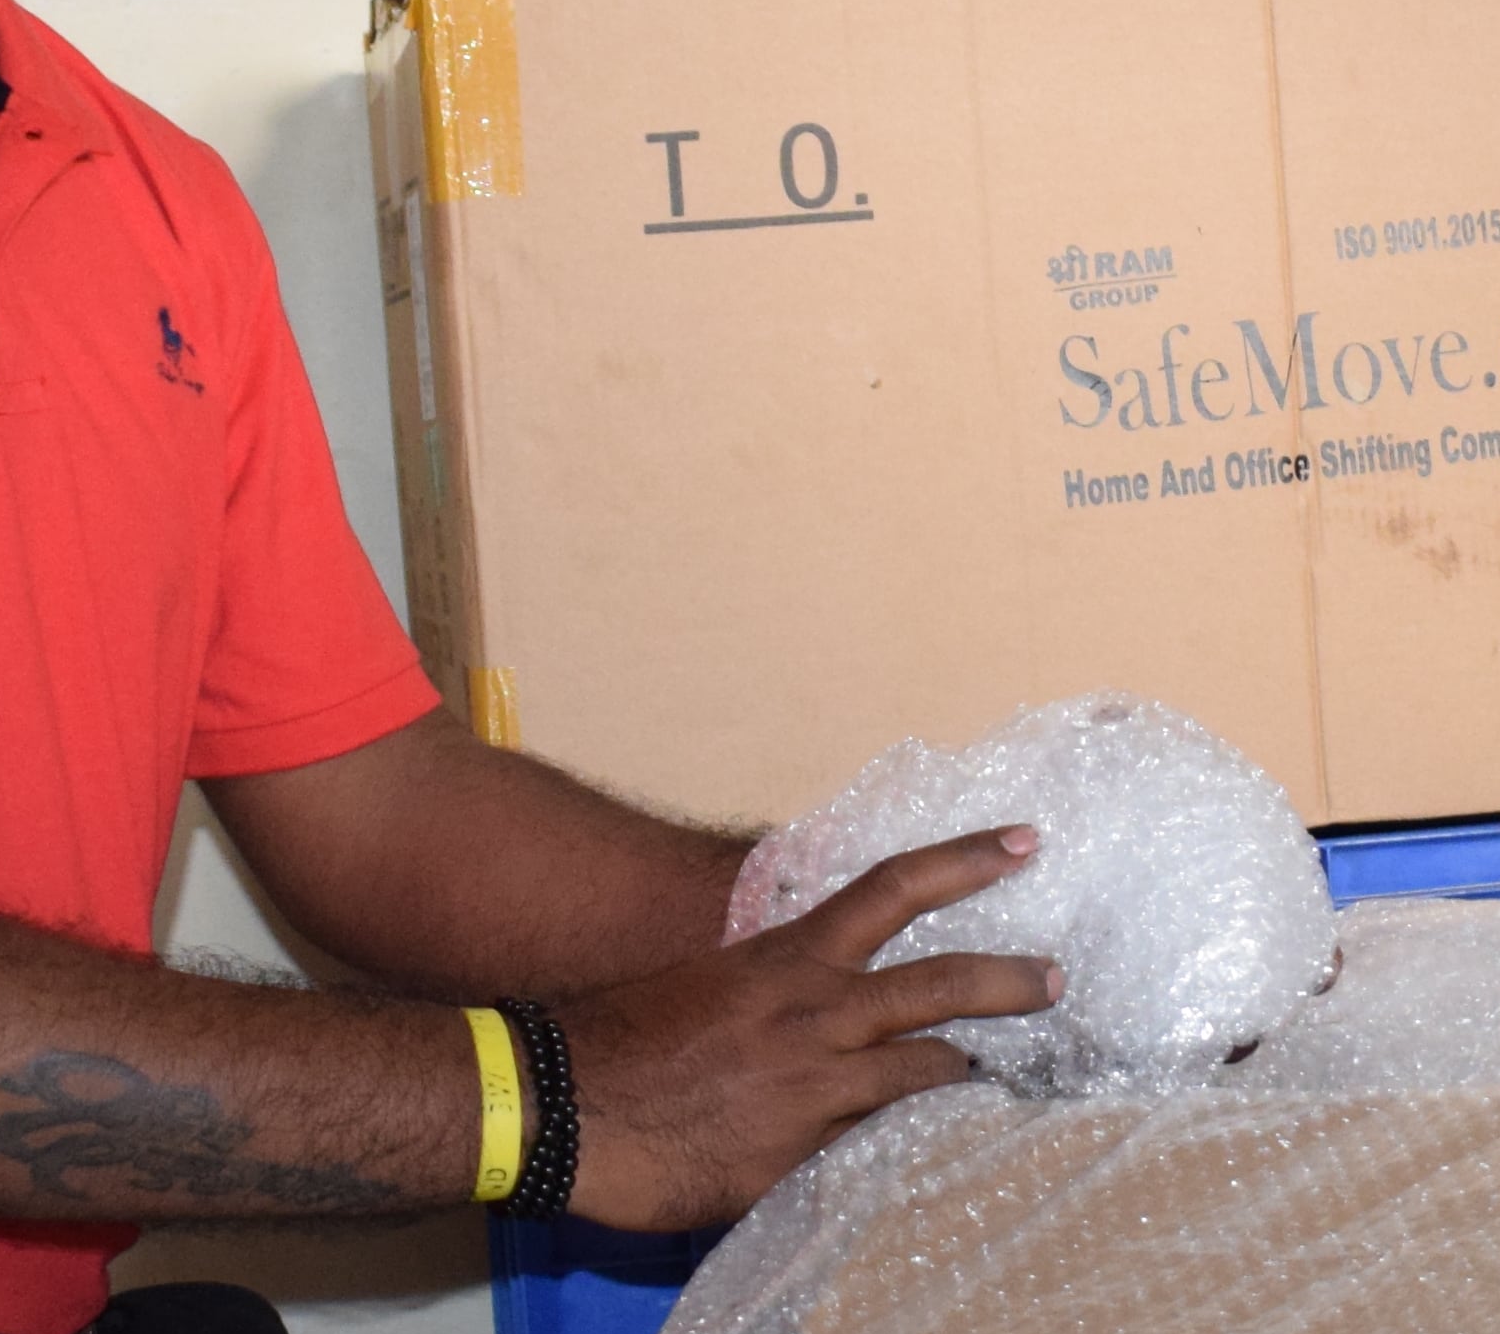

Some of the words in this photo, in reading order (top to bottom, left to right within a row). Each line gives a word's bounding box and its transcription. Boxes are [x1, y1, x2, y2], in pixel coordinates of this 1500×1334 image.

[1334, 224, 1376, 259] ISO
[1094, 246, 1173, 279] RAM
[1069, 284, 1159, 311] GROUP
[1064, 469, 1148, 508] Home
[1161, 456, 1215, 497] And
[1225, 451, 1310, 490] Office
[1321, 434, 1431, 479] Shifting
